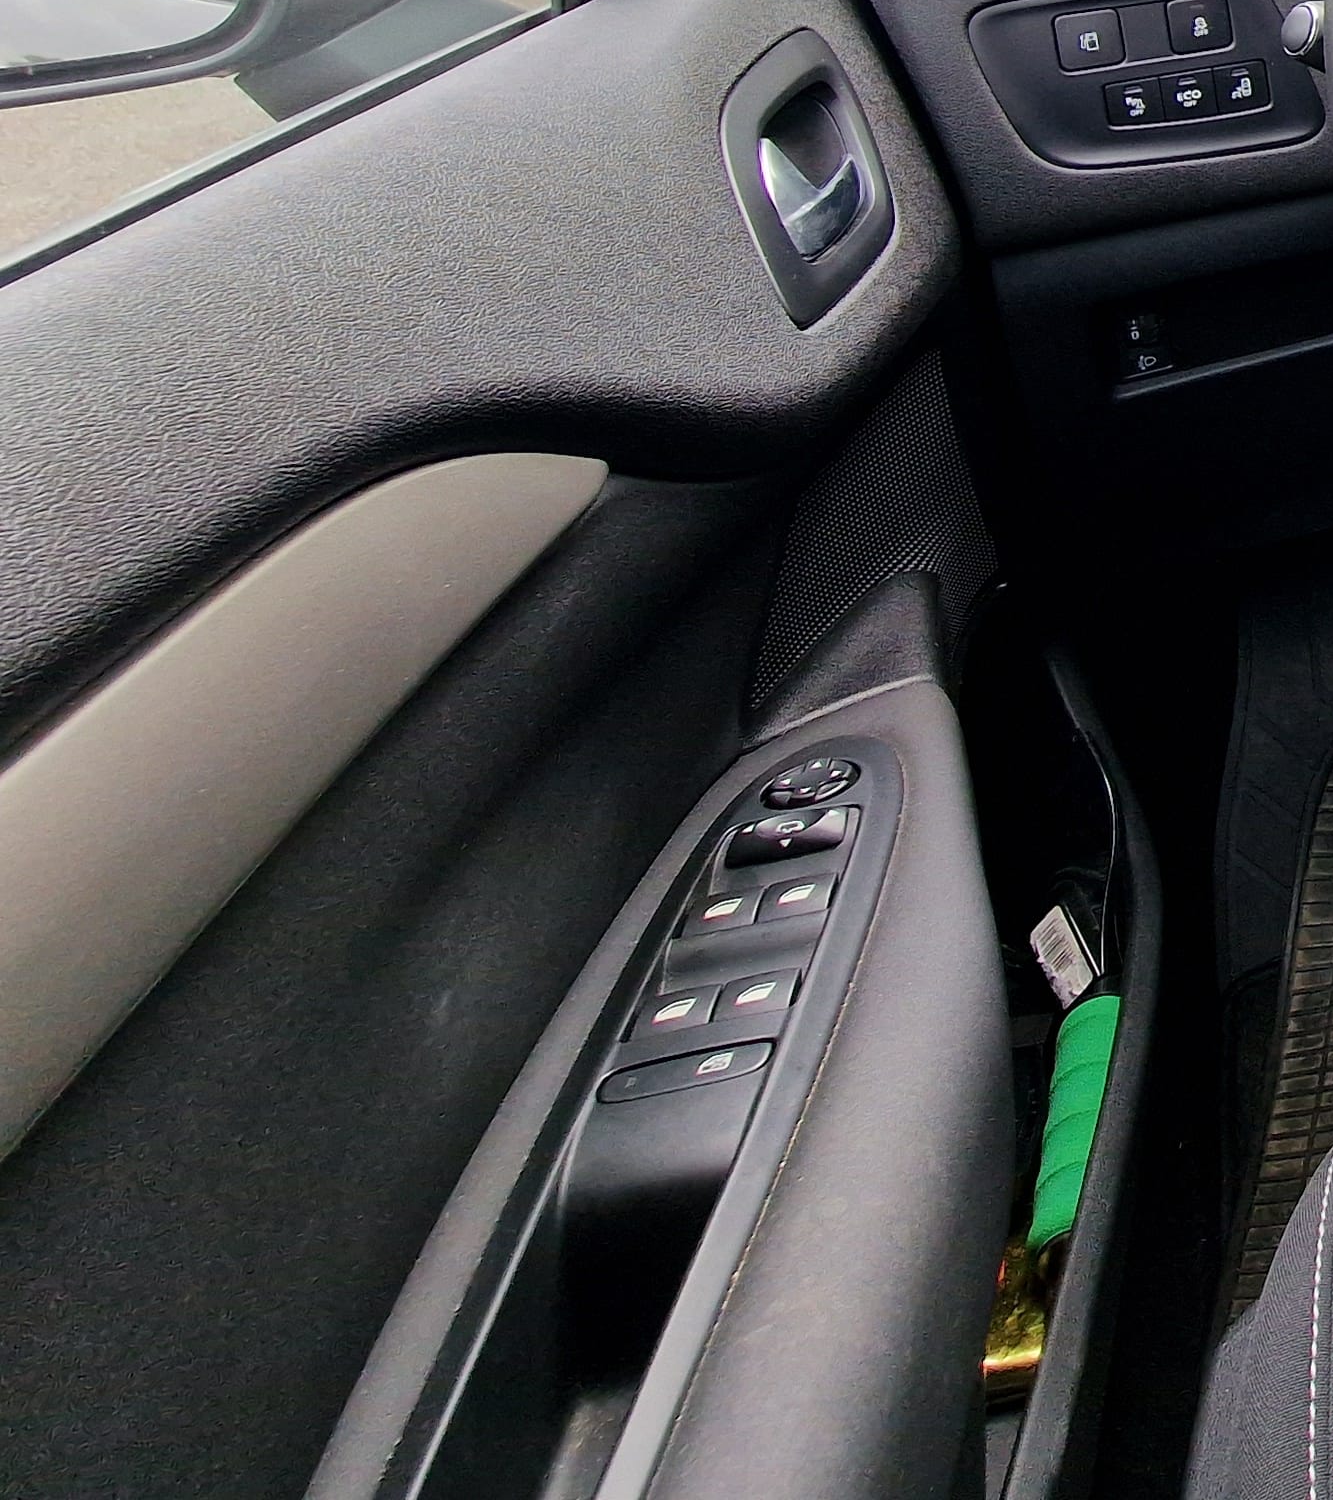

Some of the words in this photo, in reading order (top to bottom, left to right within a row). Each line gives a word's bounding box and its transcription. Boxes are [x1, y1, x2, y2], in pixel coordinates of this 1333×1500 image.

[1176, 89, 1202, 102] ECO
[1183, 99, 1198, 108] OFF
[1129, 109, 1145, 117] OFF
